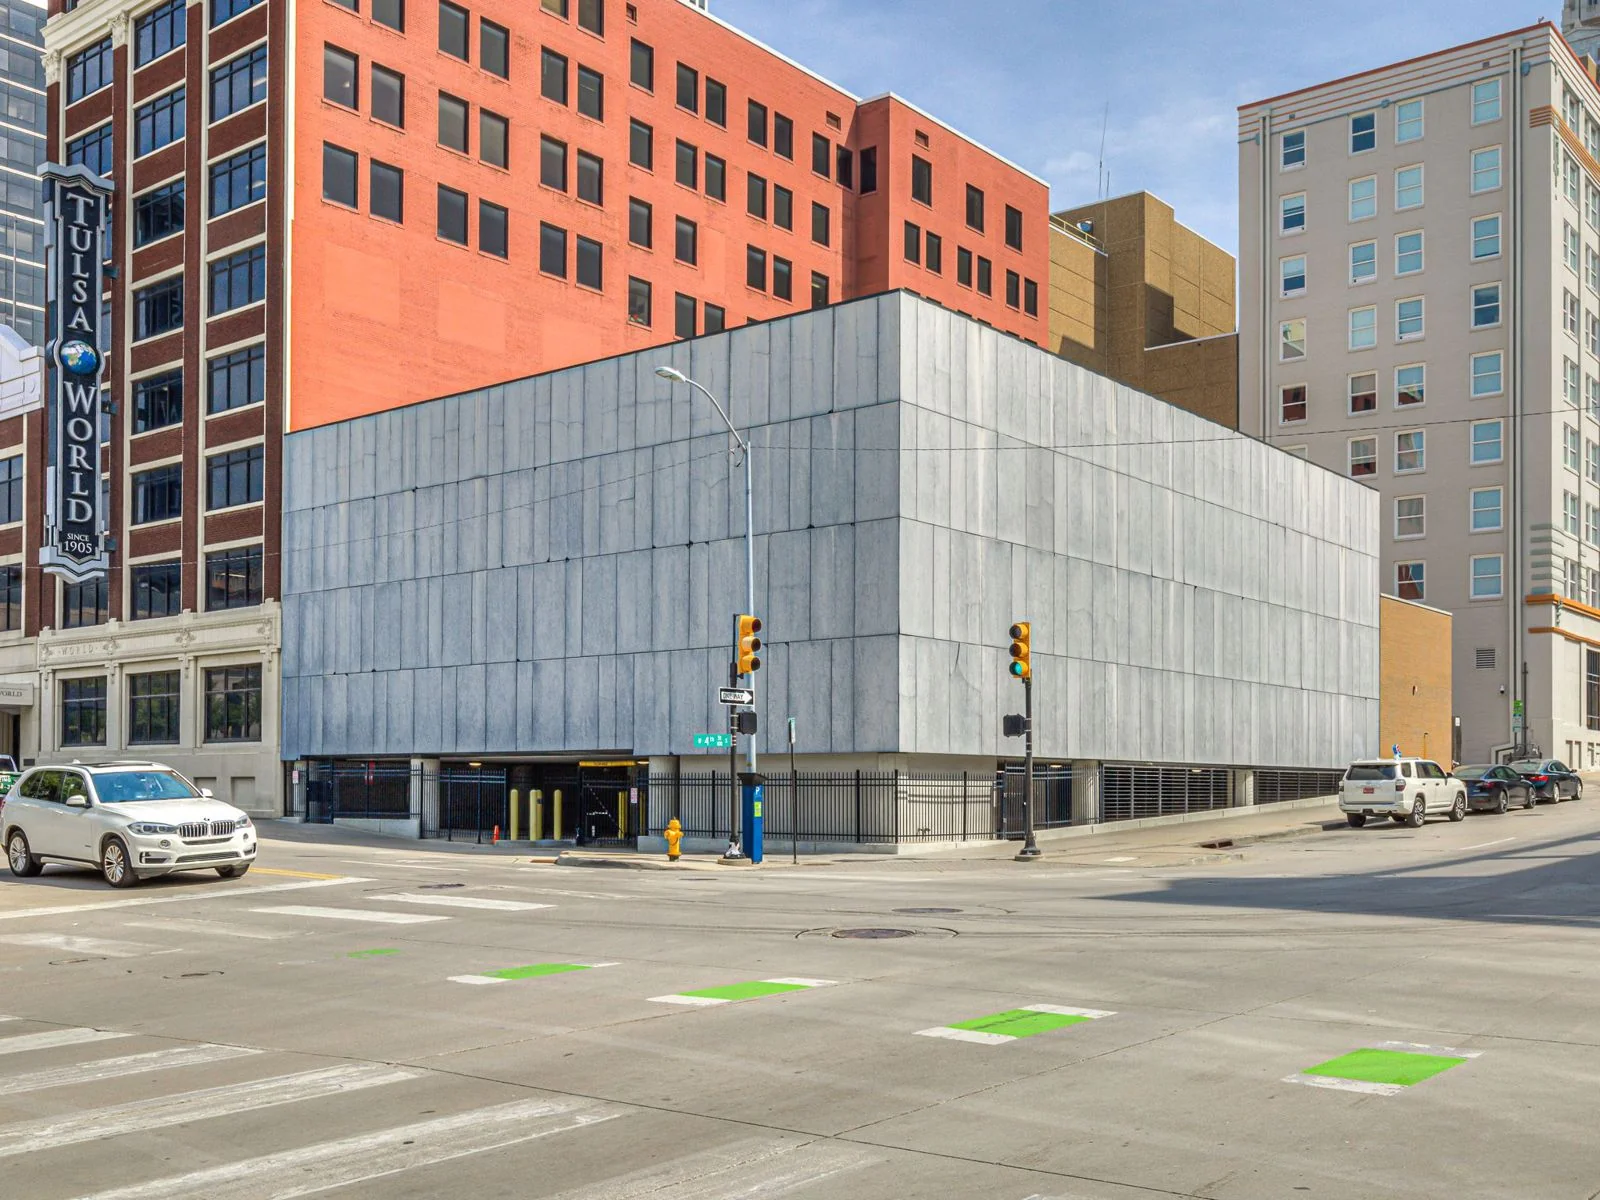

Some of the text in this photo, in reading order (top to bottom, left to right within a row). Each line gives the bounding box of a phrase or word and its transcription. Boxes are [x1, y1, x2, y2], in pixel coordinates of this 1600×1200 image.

[66, 192, 94, 333] TULSA
[64, 381, 97, 523] WORLD
[67, 533, 90, 542] SINCE
[64, 540, 93, 554] 1905
[61, 645, 93, 655] WORLD
[733, 692, 744, 700] WAY
